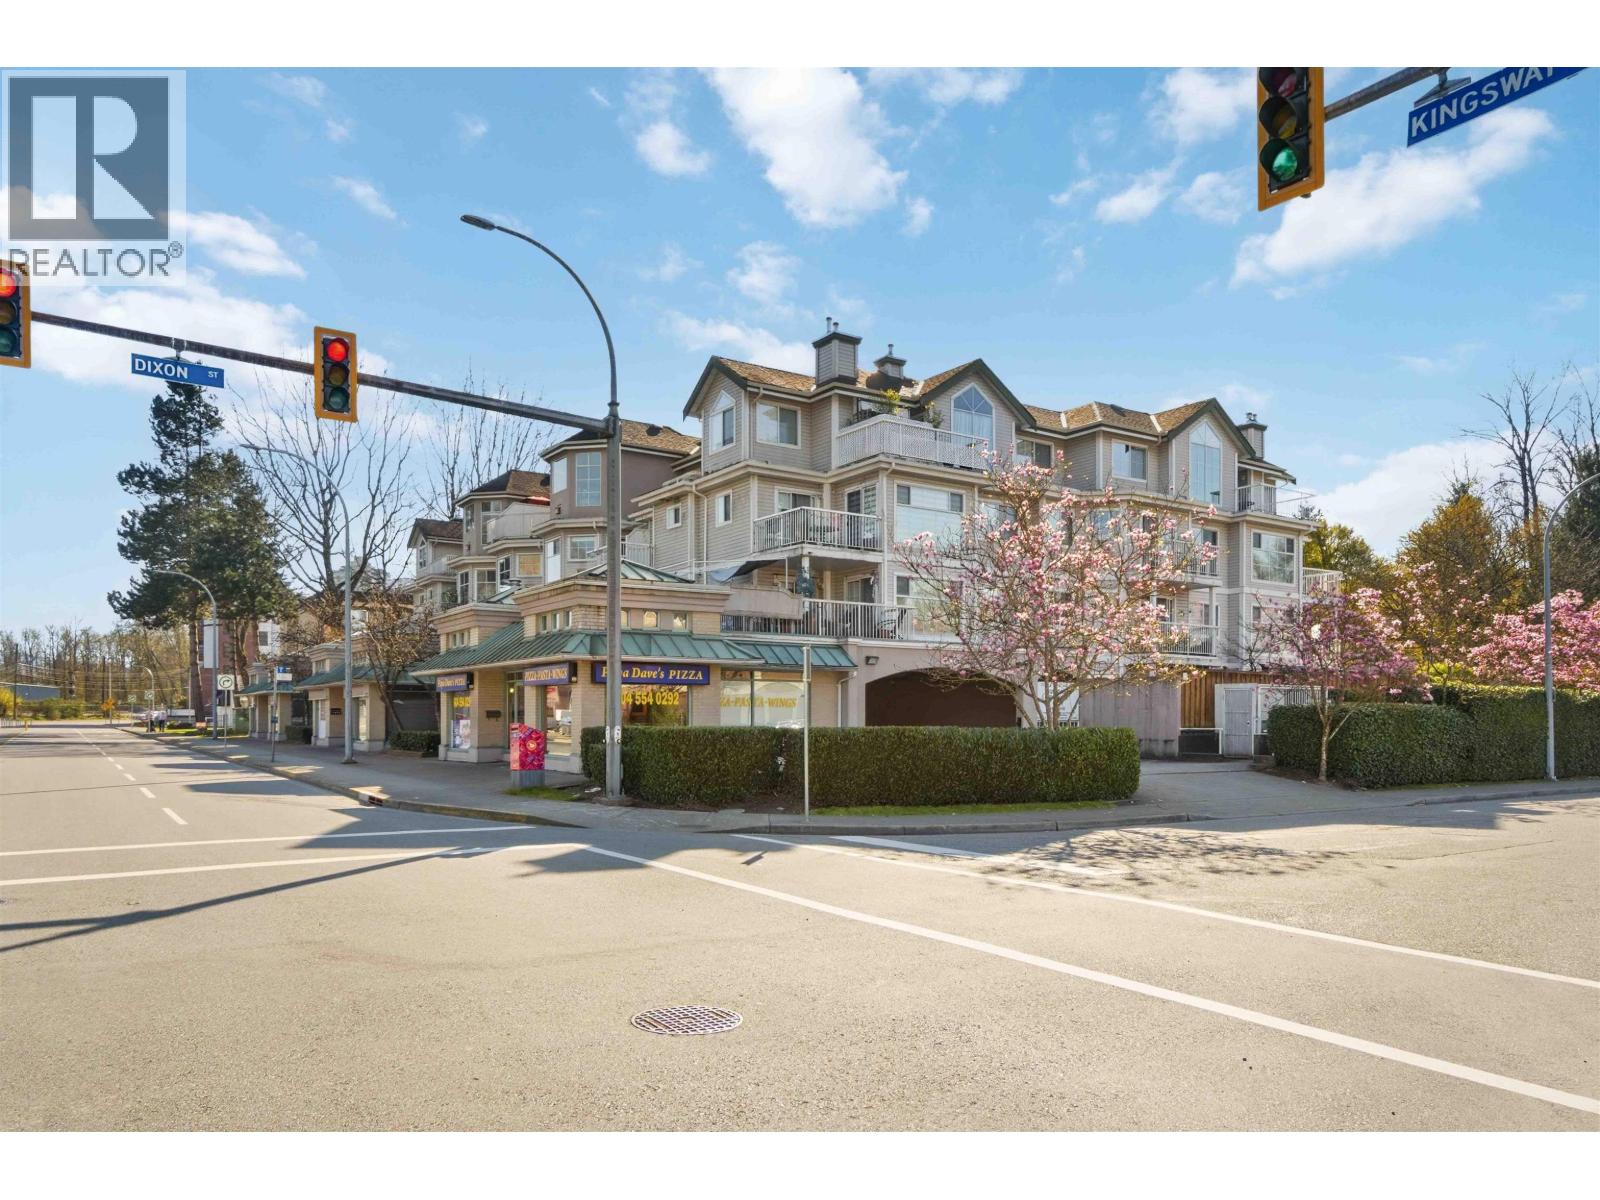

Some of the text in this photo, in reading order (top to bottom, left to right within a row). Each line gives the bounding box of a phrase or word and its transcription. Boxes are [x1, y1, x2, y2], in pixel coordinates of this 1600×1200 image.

[135, 358, 219, 379] DIXON ST
[601, 666, 704, 680] Pa Dave's PIZZA
[635, 691, 654, 705] 554
[656, 691, 680, 705] 0292
